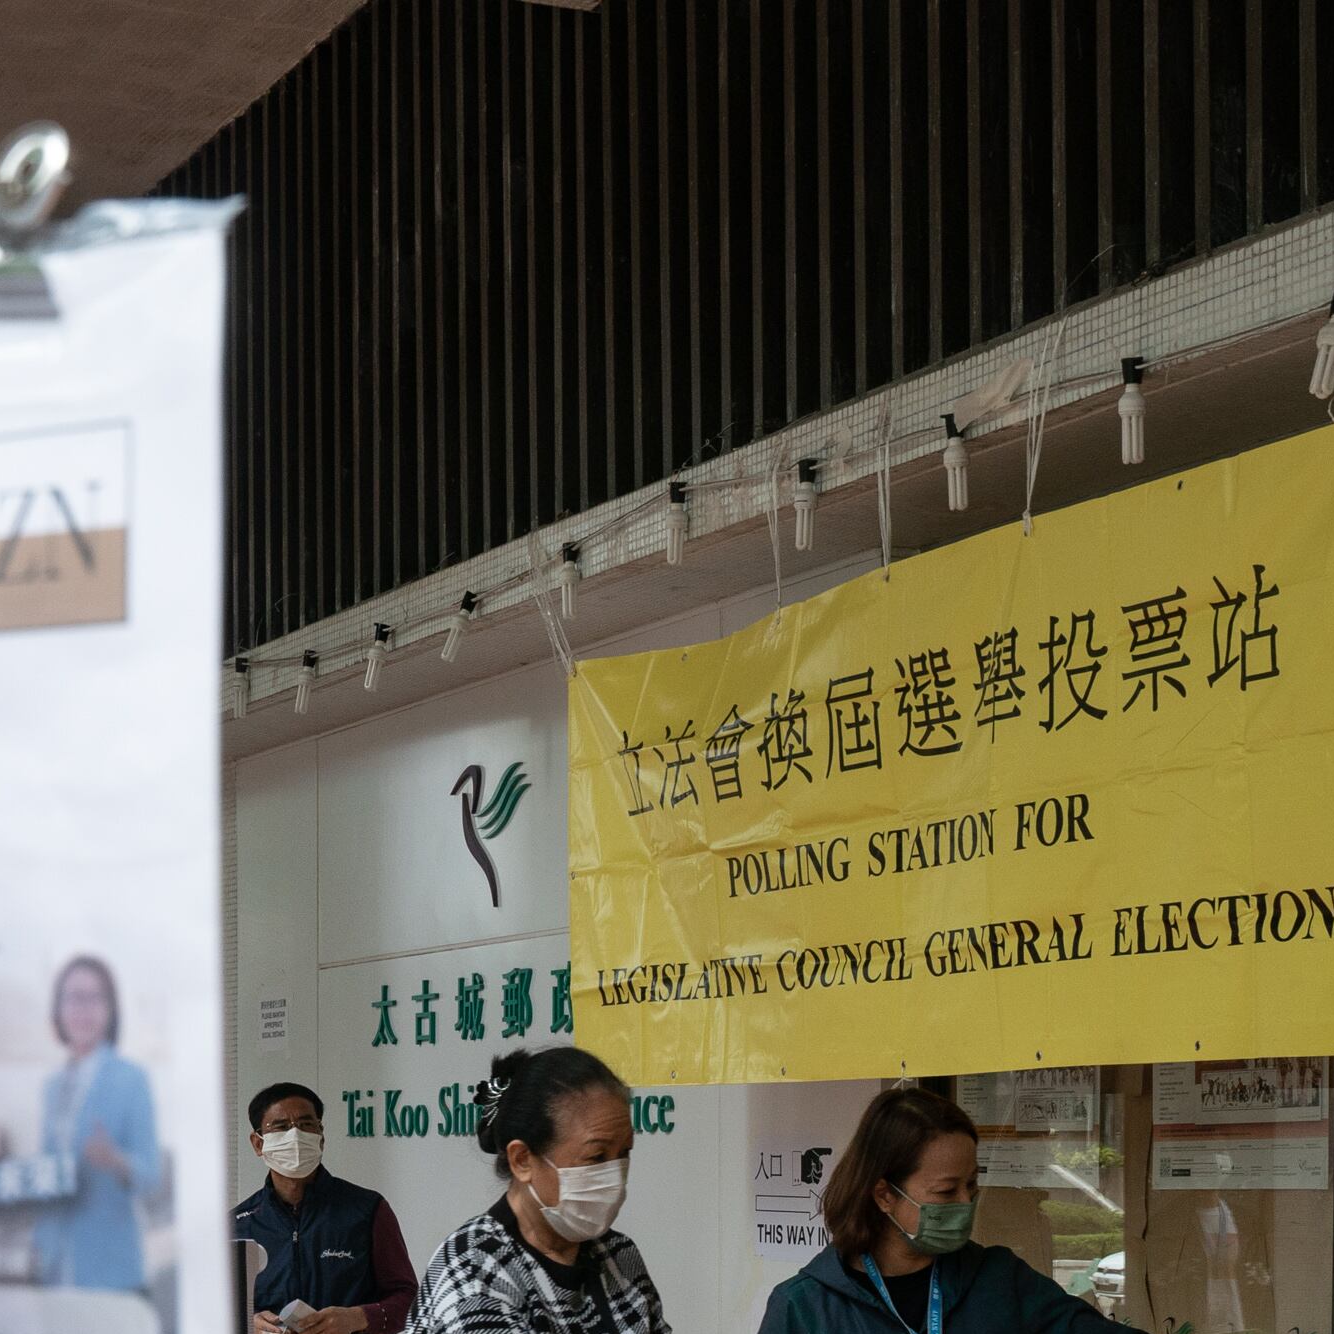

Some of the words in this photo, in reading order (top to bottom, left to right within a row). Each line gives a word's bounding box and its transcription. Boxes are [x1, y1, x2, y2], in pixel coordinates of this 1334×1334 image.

[618, 564, 1280, 817] 立法會換屆選舉投票站
[726, 837, 851, 897] POLLING
[867, 809, 997, 876] STATION
[1014, 793, 1094, 851] FOR
[597, 954, 767, 1007] LEGISLATIVE
[776, 937, 913, 992] COUNCIL
[924, 912, 1093, 977] GENERAL
[342, 1089, 375, 1138] Tai
[383, 1089, 429, 1138] Koo
[755, 1152, 782, 1181] 入口
[757, 1224, 784, 1244] THIS
[787, 1225, 815, 1246] WAY
[932, 1309, 940, 1331] STAFF
